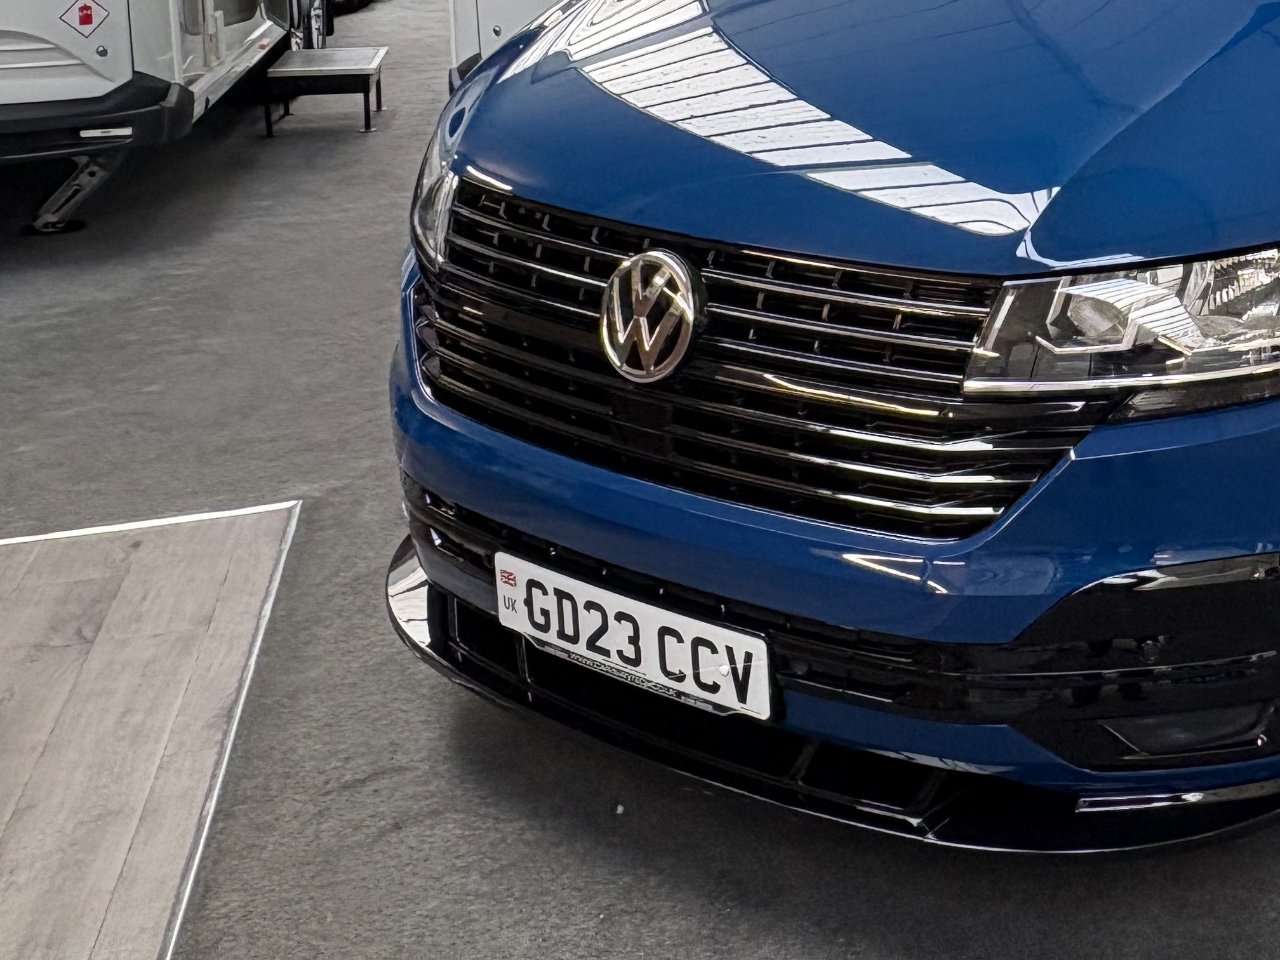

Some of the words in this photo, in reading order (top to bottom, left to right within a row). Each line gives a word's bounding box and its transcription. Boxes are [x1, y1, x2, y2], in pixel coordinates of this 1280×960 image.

[503, 594, 518, 614] UK
[523, 578, 642, 668] GD23
[657, 625, 753, 705] CCV
